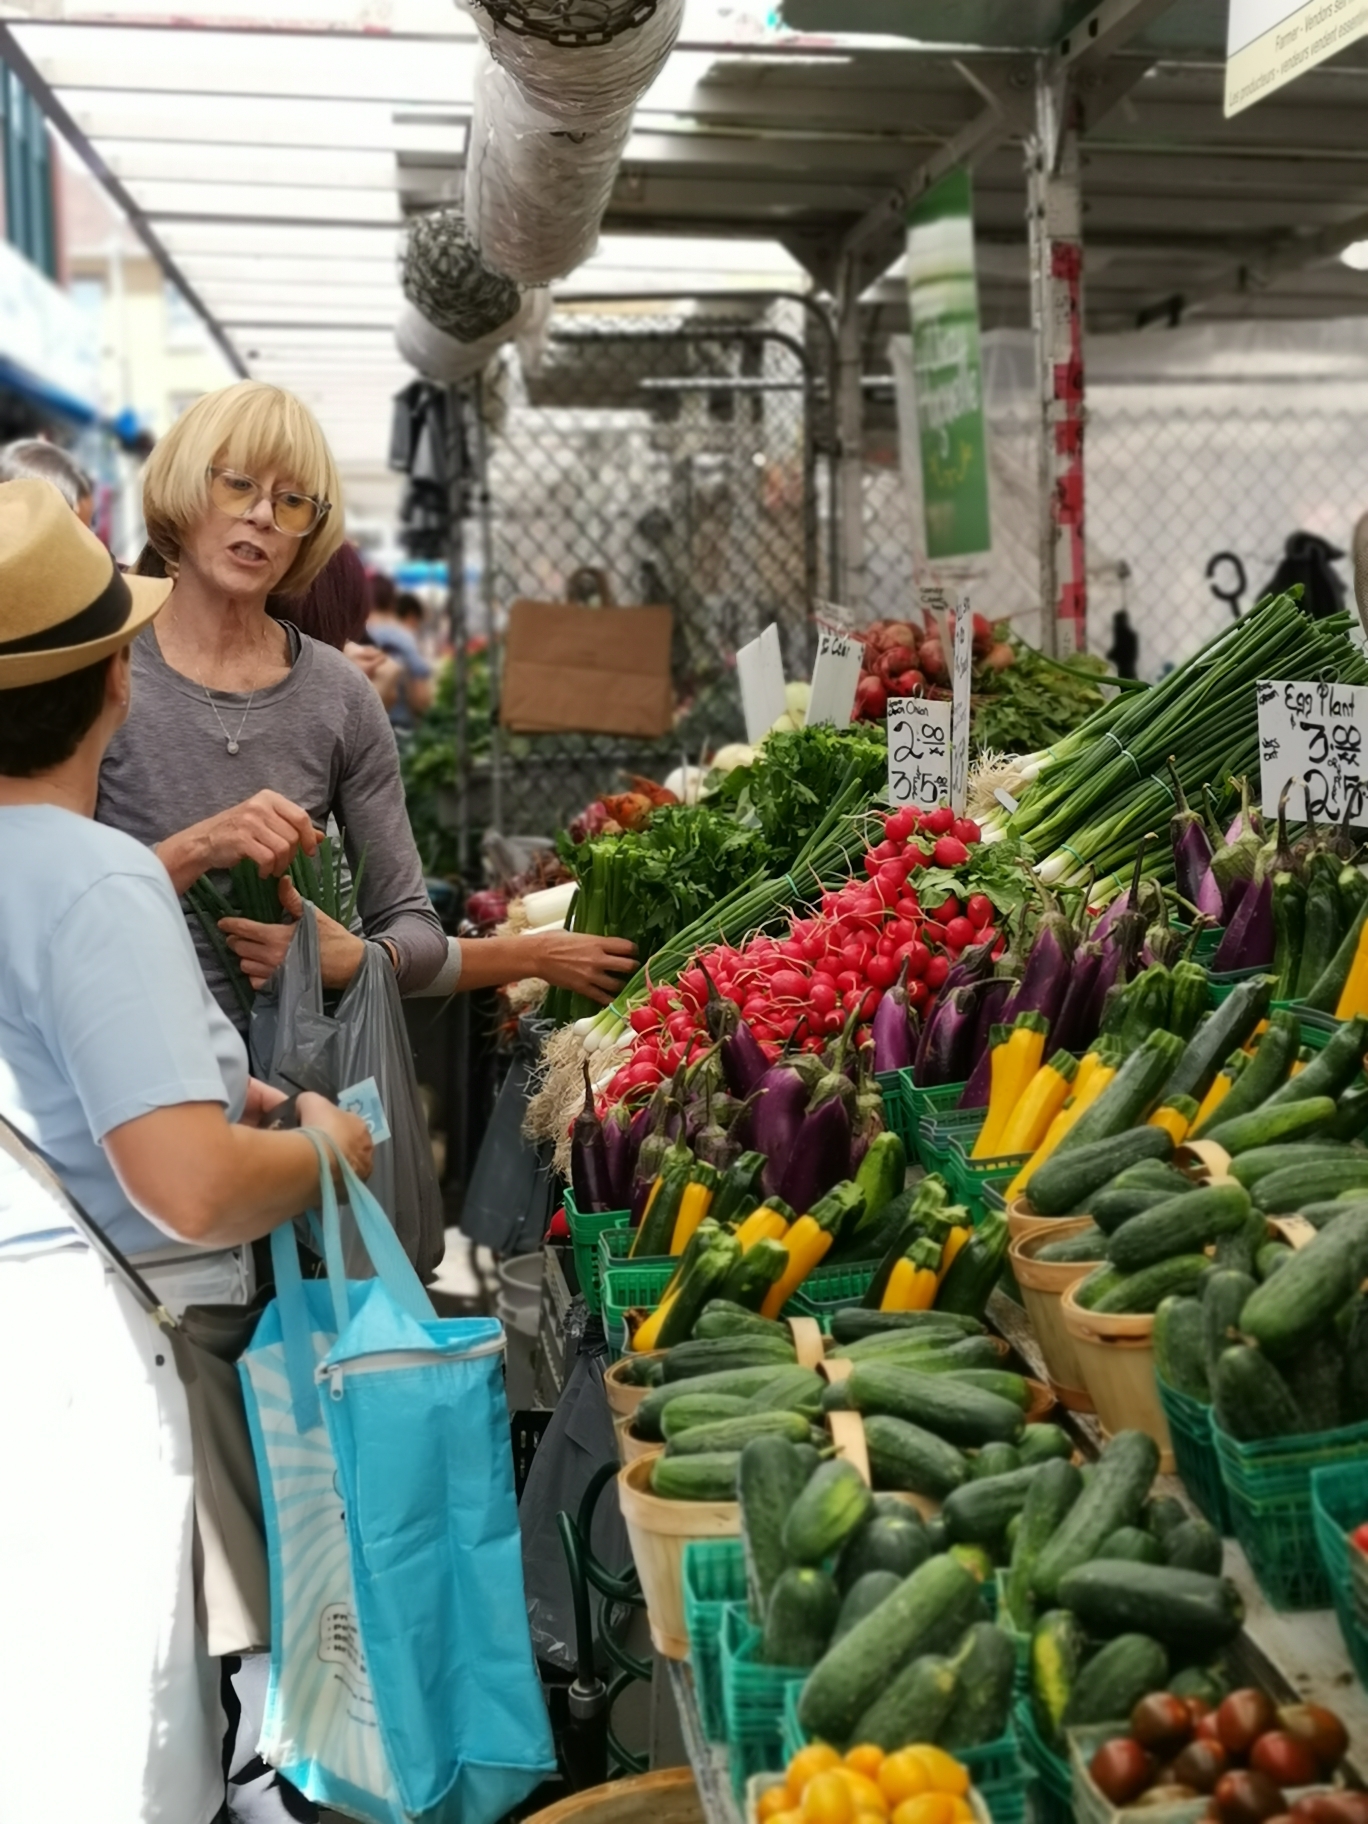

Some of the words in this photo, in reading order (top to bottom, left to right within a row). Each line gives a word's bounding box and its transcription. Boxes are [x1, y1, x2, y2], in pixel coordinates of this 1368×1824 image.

[1275, 26, 1299, 52] Farmer
[1305, 4, 1333, 33] Vendors
[1228, 91, 1240, 107] Les
[1240, 68, 1276, 104] producteurs
[1280, 47, 1309, 75] vendeurs
[1310, 24, 1337, 56] vendent
[906, 701, 929, 717] Onion
[1284, 683, 1312, 719] Egg
[1317, 684, 1355, 717] Plant
[891, 770, 911, 800] 3
[1303, 769, 1340, 821] 2
